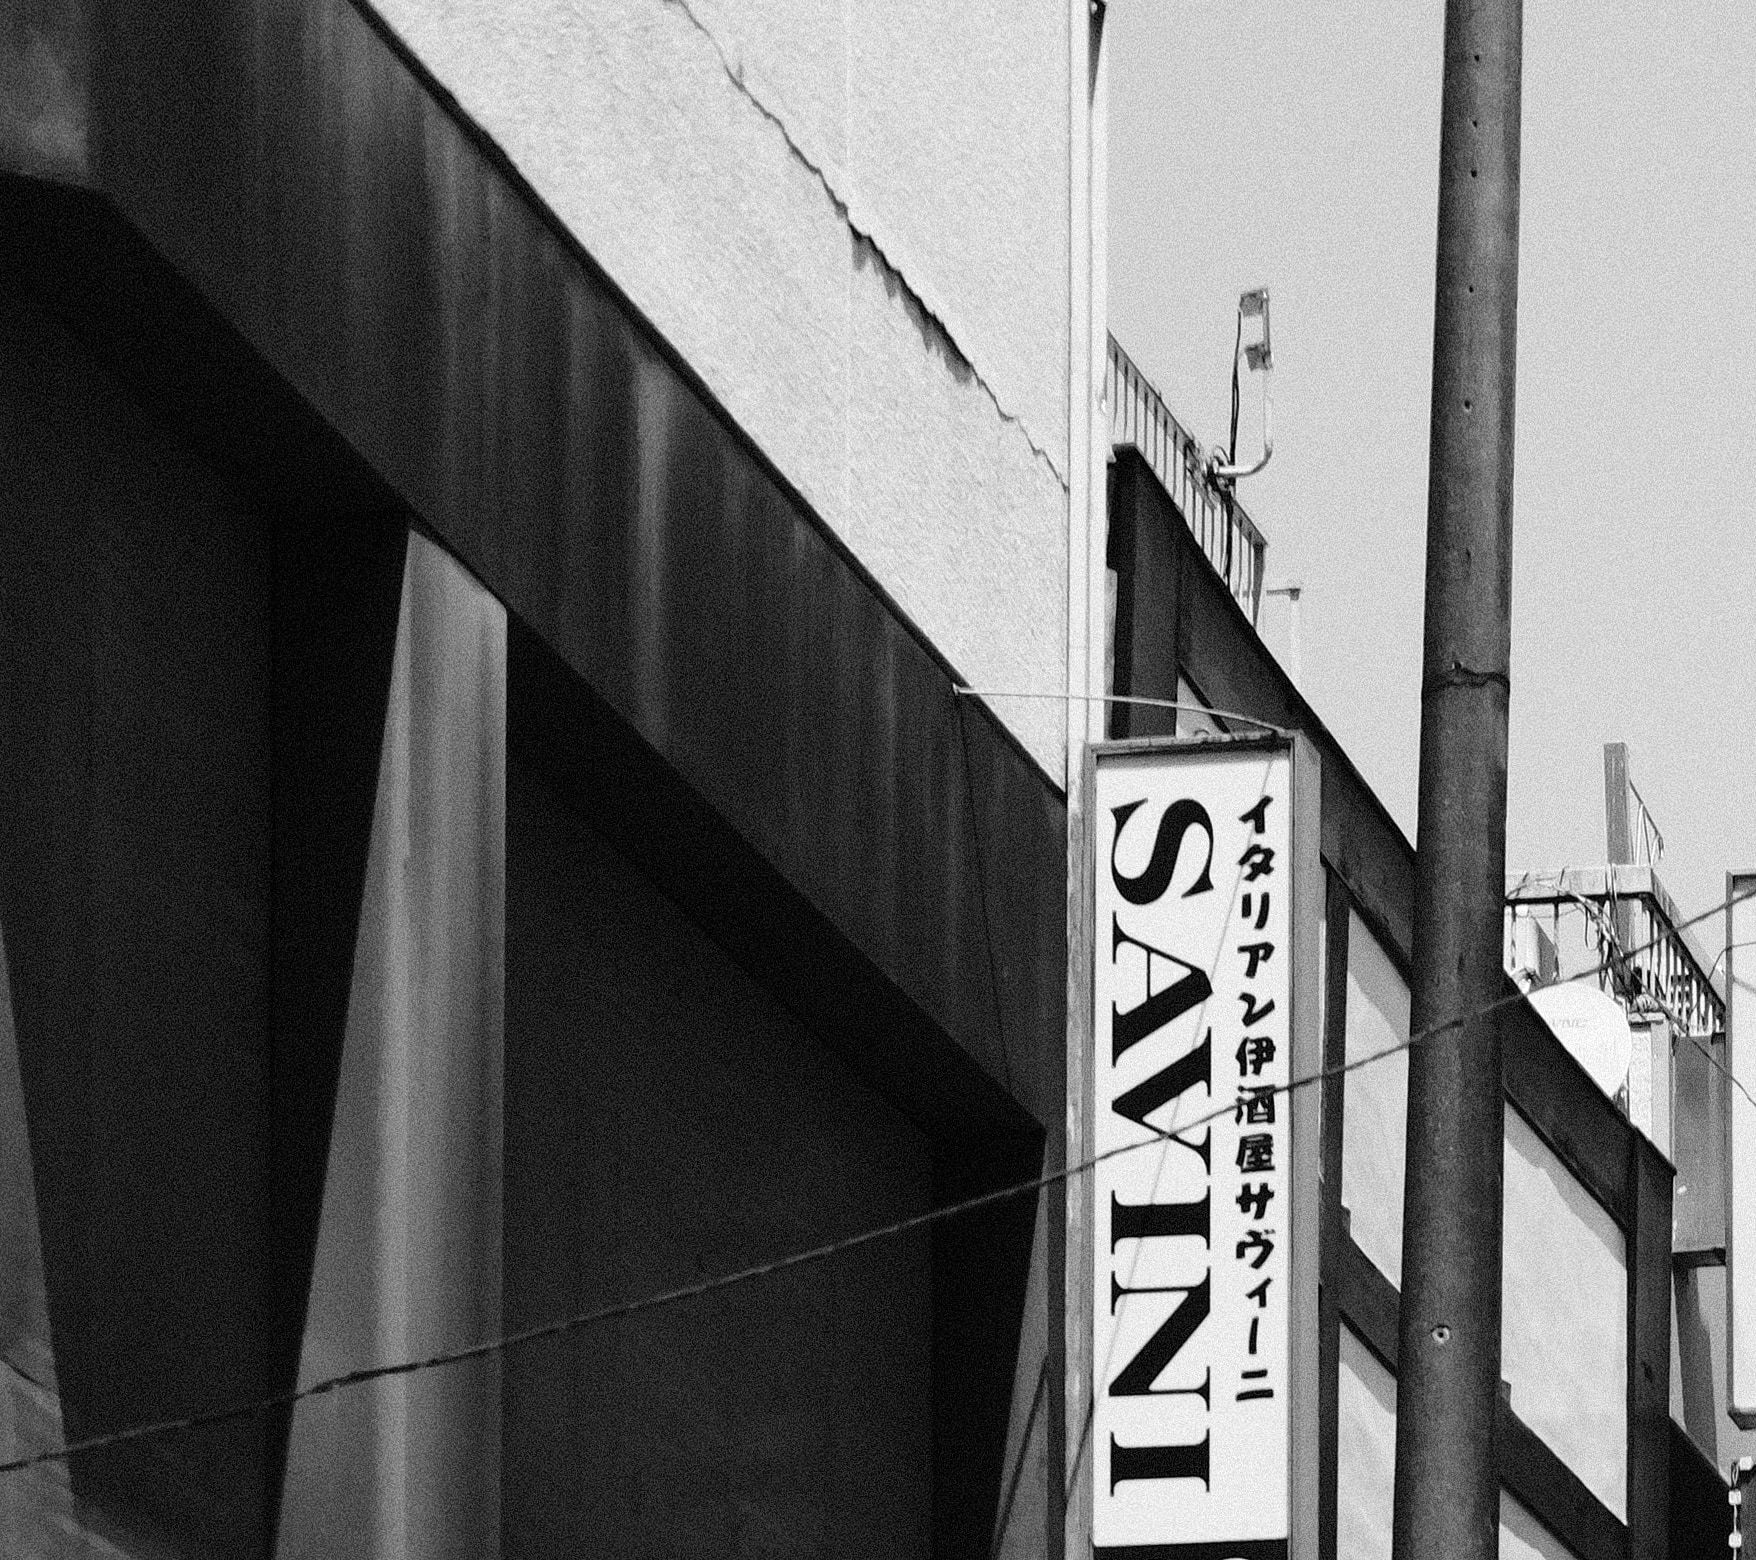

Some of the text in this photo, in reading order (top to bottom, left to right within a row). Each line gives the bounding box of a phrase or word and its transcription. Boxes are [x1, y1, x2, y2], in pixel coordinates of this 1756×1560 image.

[1108, 797, 1214, 1497] SAVINI
[1234, 795, 1277, 1403] イタリアン伊酒屋サヴィーニ
